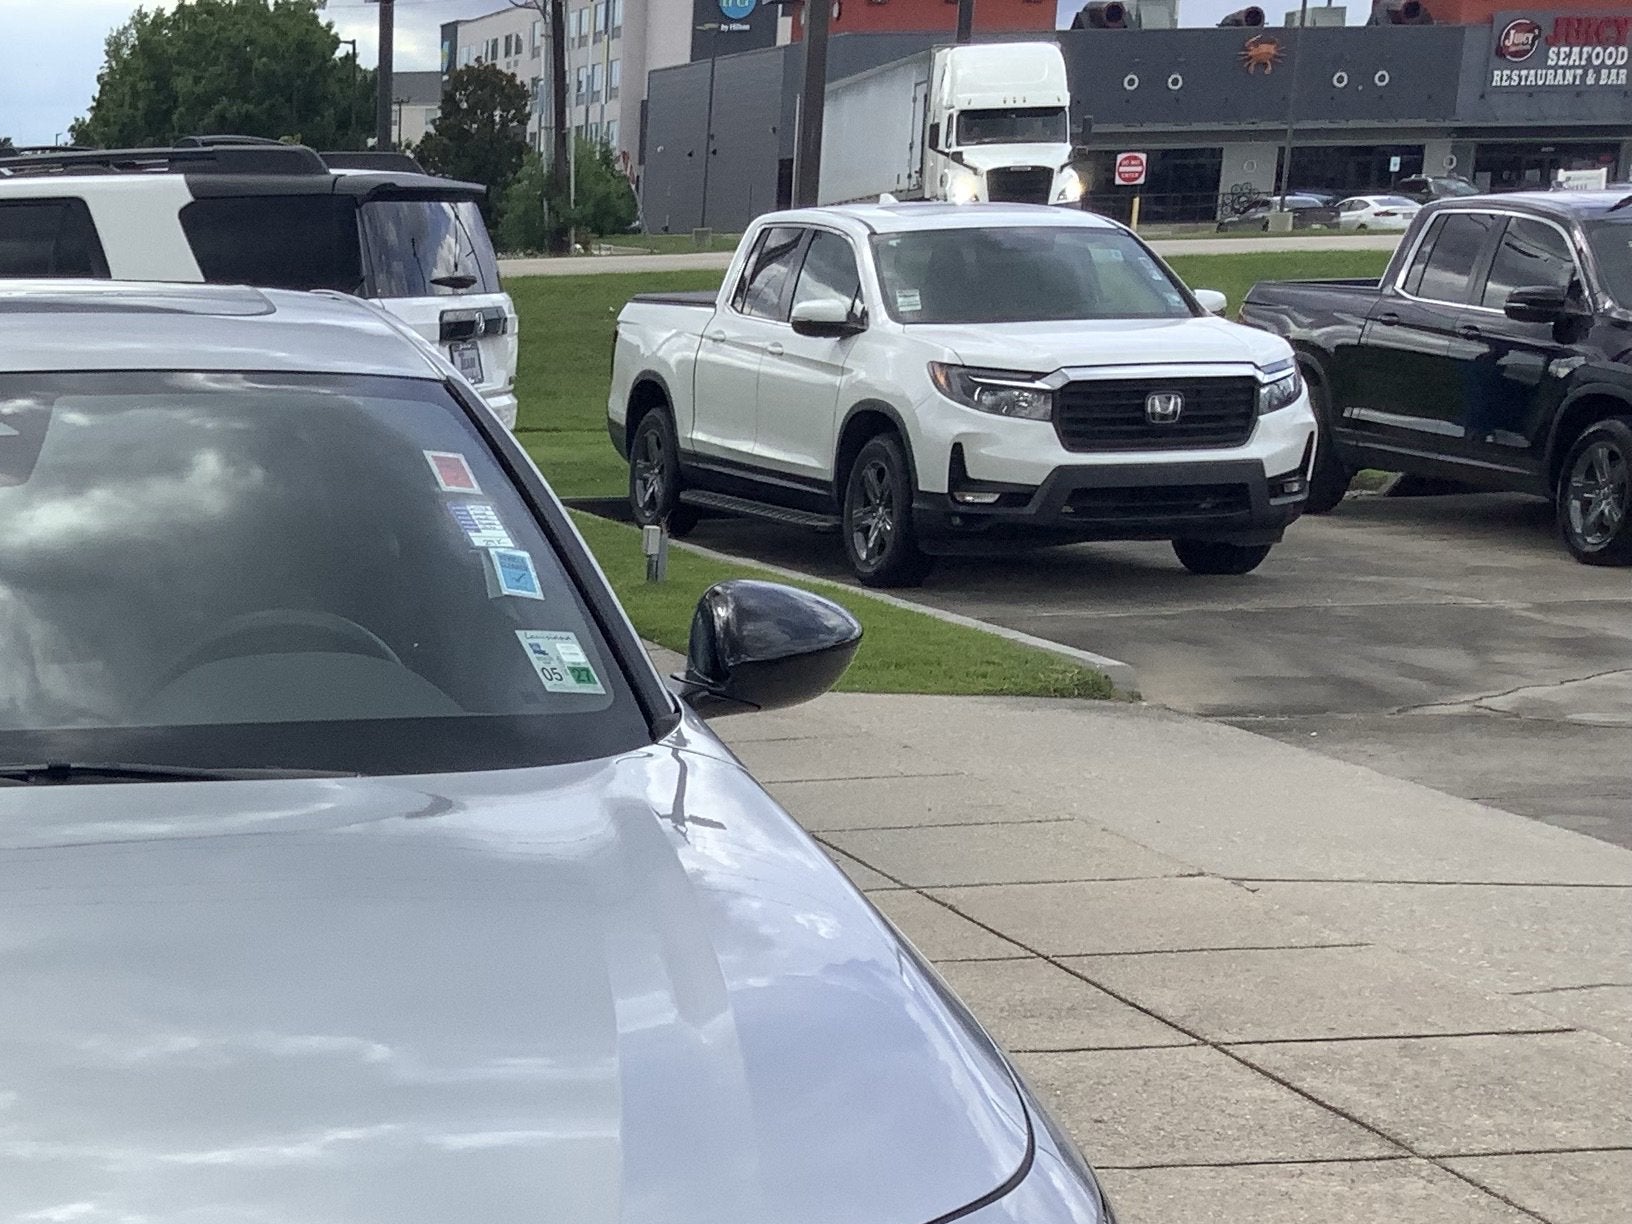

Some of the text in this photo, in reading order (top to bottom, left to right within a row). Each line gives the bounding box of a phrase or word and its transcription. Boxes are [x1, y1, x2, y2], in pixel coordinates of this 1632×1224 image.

[1547, 46, 1629, 66] SEAFOOD
[1492, 68, 1628, 87] RESTAURANT & BAR
[540, 667, 592, 682] 05 27
